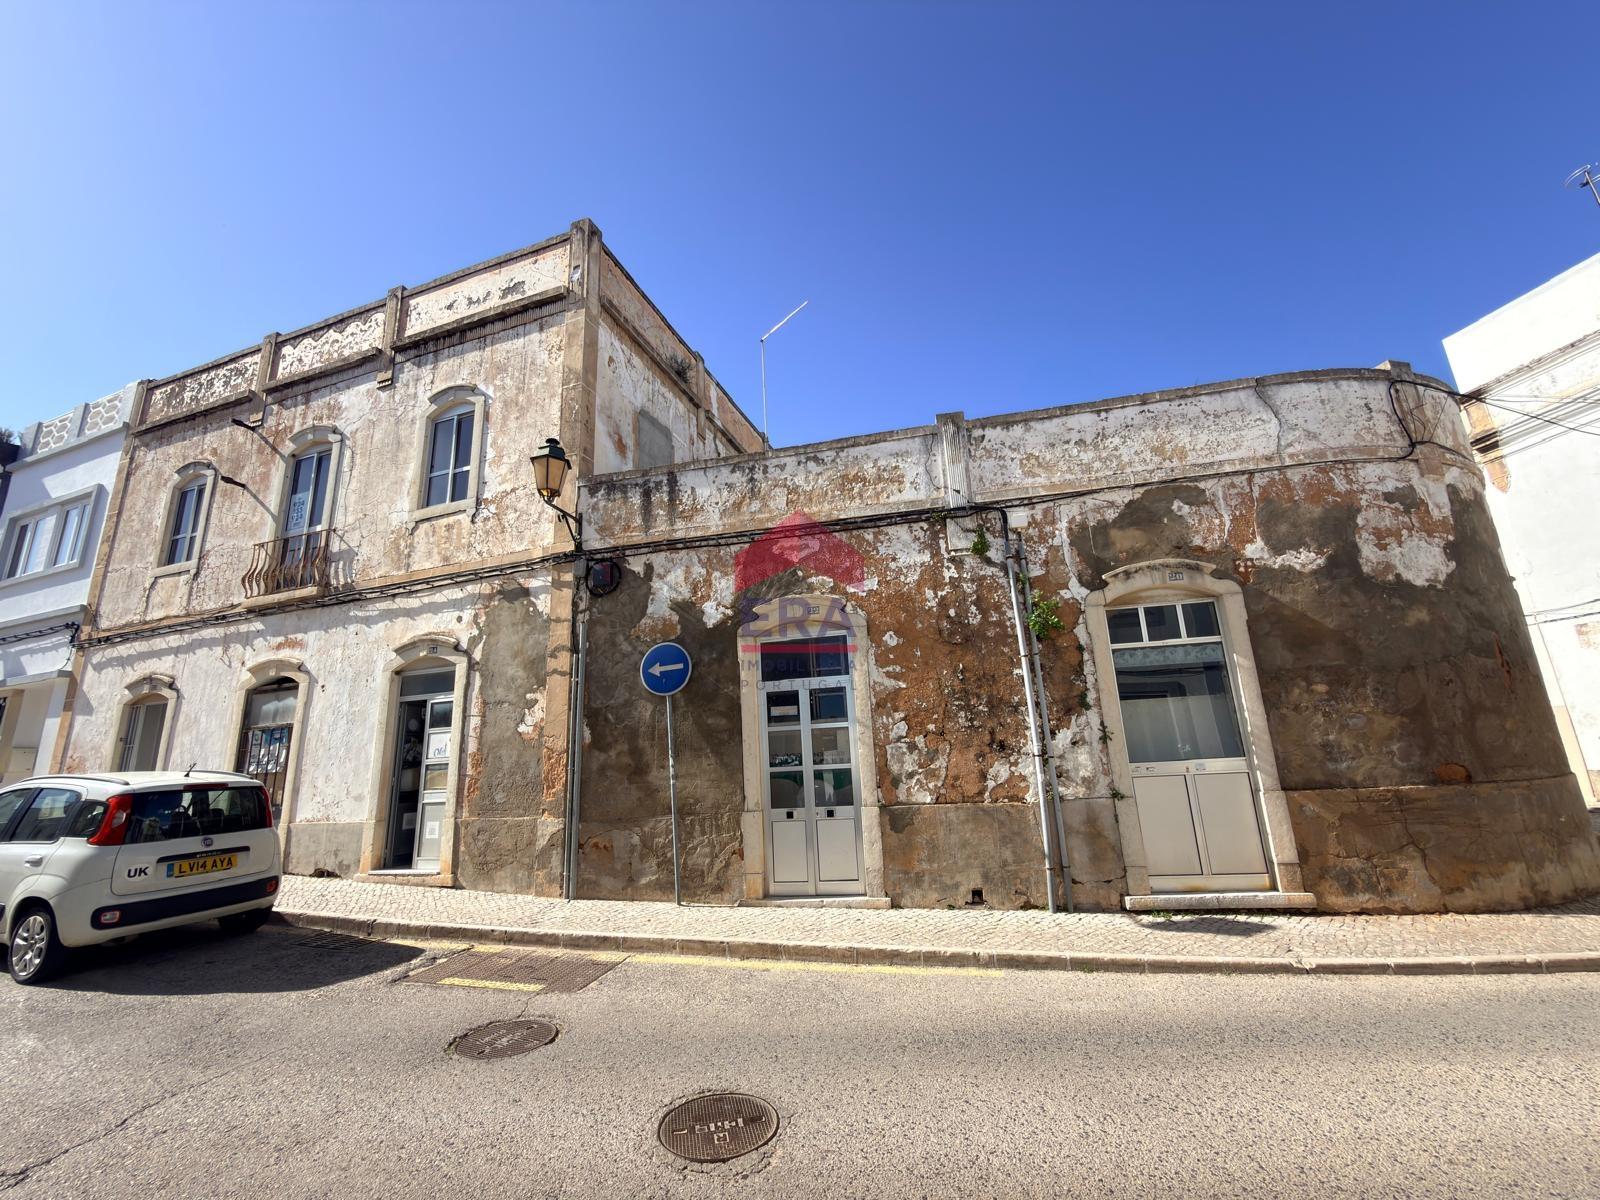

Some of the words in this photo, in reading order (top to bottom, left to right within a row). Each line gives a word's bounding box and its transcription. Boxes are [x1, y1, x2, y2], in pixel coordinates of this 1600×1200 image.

[127, 866, 150, 878] UK
[179, 860, 207, 874] LV14
[211, 857, 233, 870] AYA
